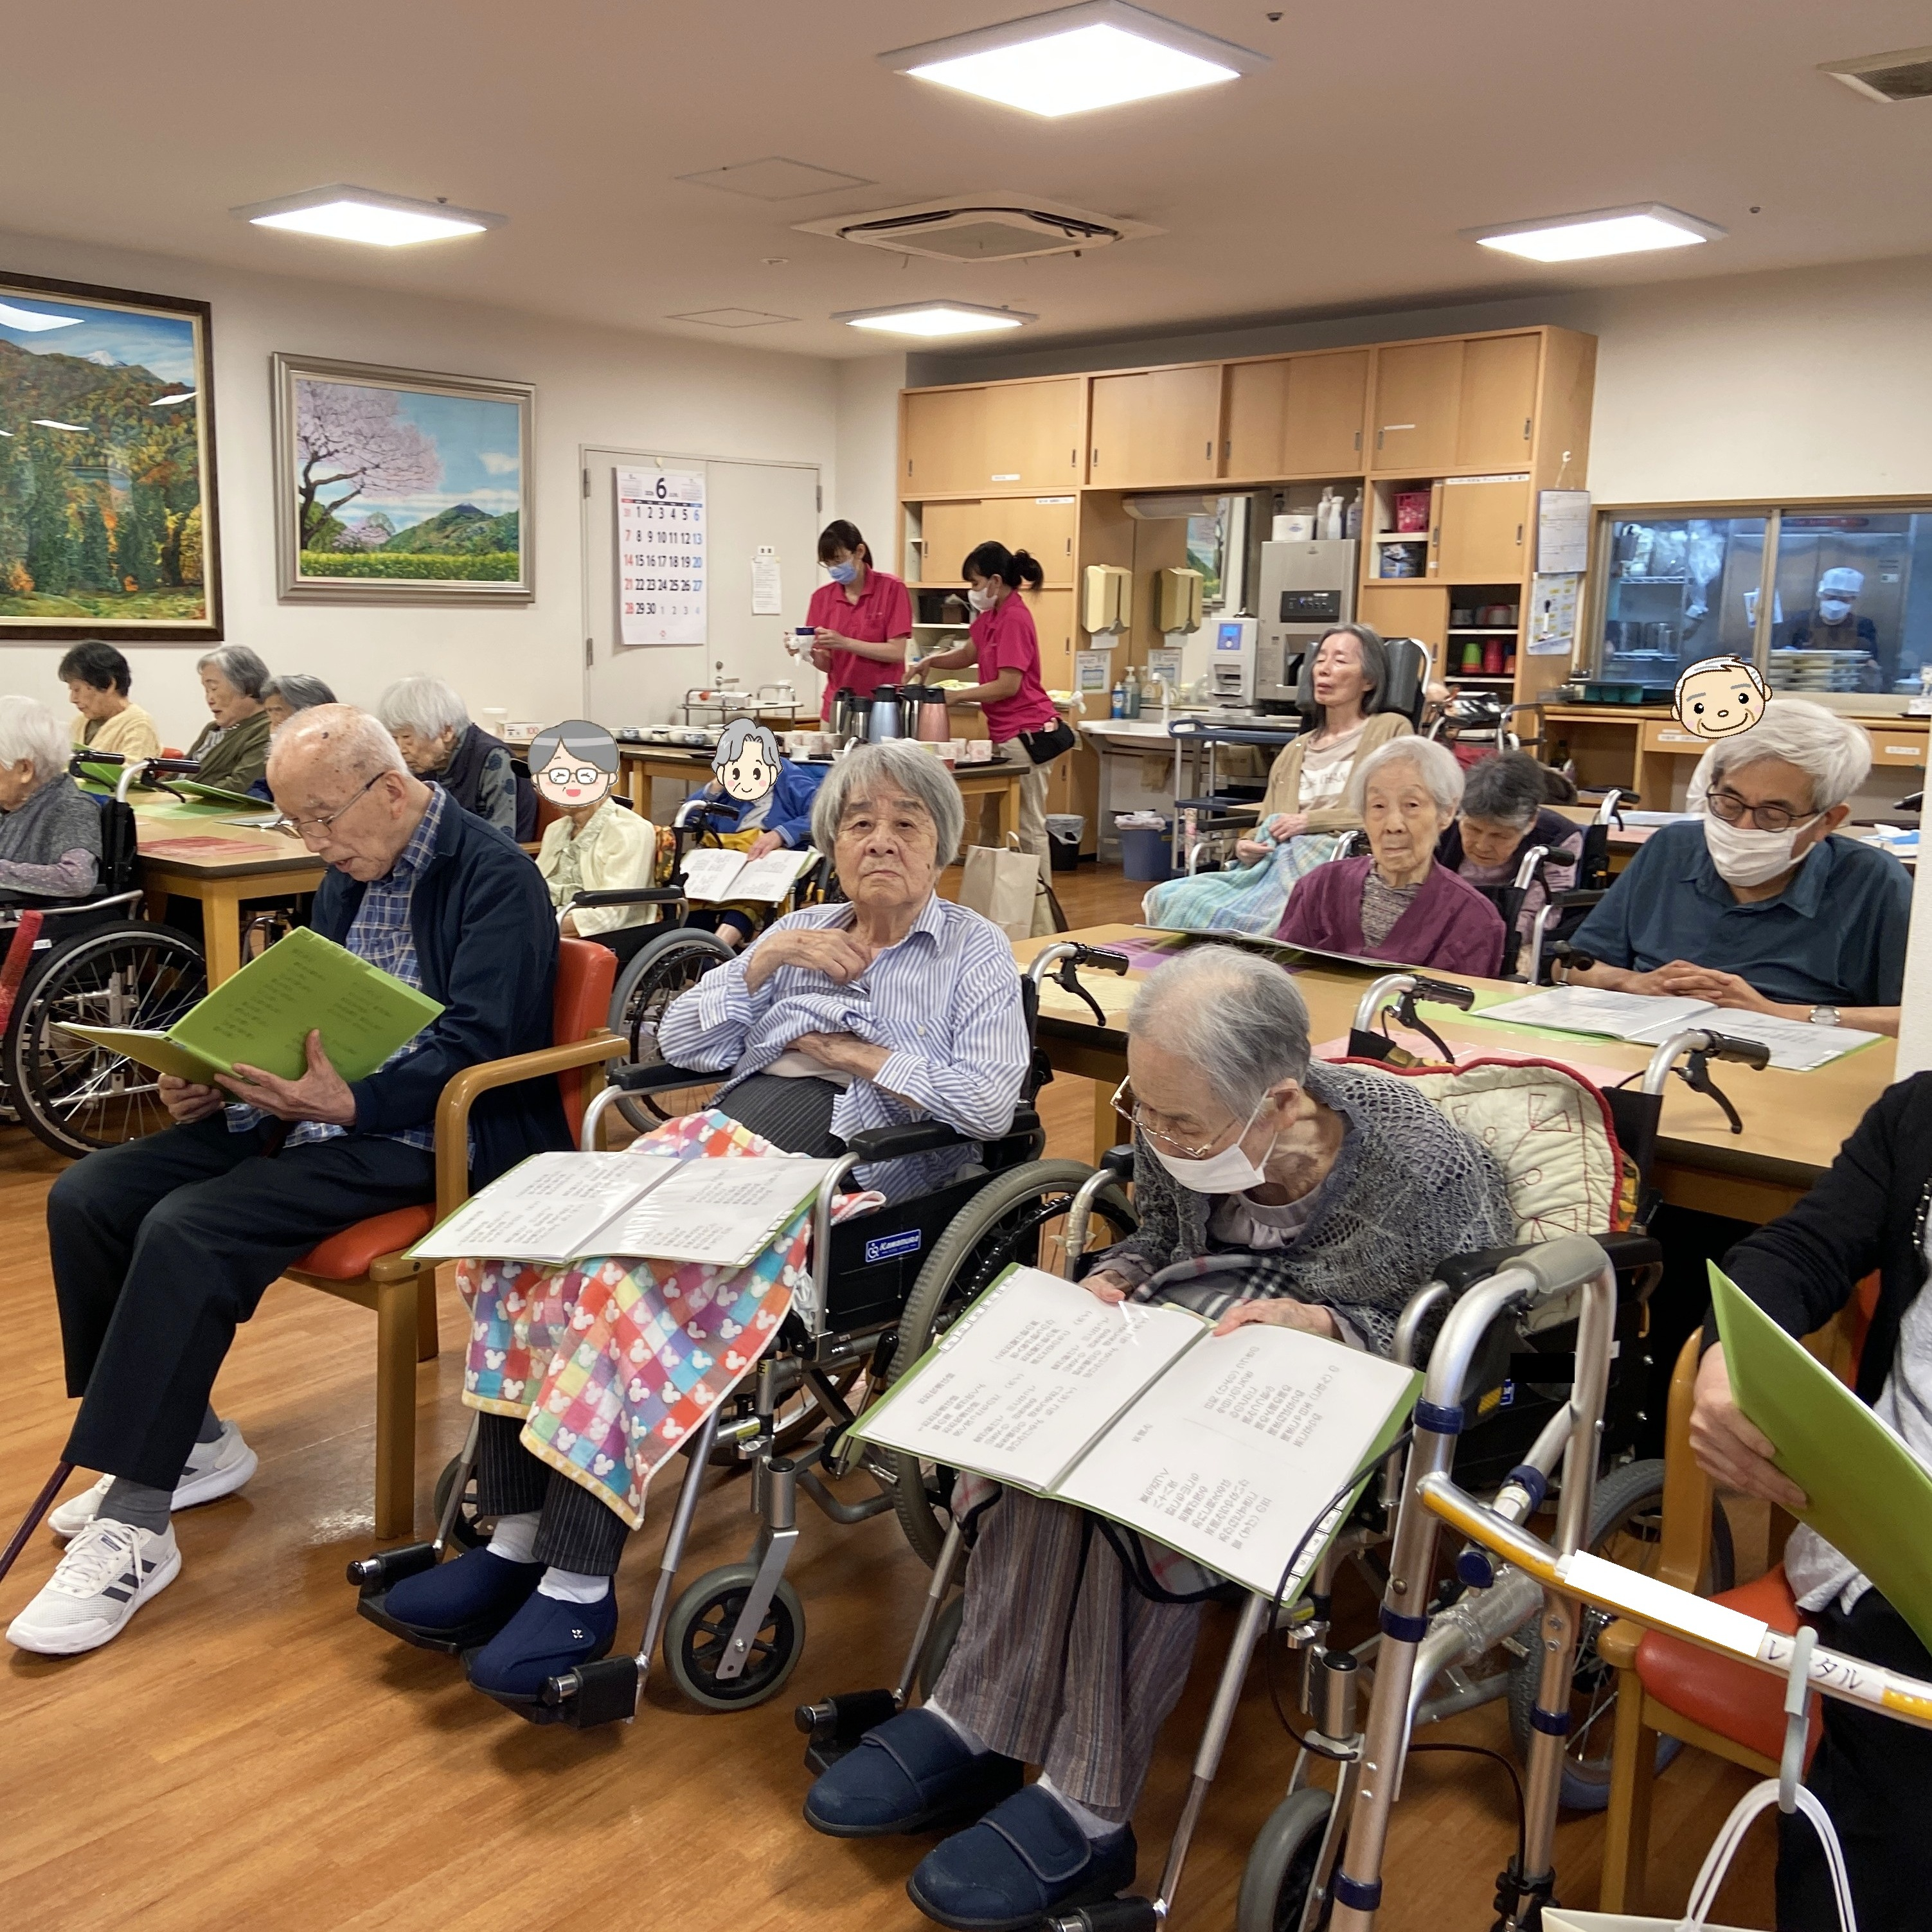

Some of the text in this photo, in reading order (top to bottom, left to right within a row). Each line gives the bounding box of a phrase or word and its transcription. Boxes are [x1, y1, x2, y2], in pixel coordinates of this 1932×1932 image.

[656, 478, 666, 499] 6
[637, 506, 641, 517] 1
[648, 506, 653, 519] 2
[659, 507, 664, 519] 3
[671, 508, 675, 520] 4
[683, 508, 688, 521] 5
[694, 509, 700, 521] 6
[625, 530, 702, 544] 7 8 9 10 11 12 13
[624, 554, 702, 568] 14 15 16 17 18 19 20
[624, 578, 702, 592] 21 22 23 24 25 26 27
[625, 602, 634, 614] 28
[636, 602, 645, 614] 29
[646, 602, 656, 614] 30
[672, 605, 677, 615] 2
[1768, 1640, 1864, 1689] レタル
